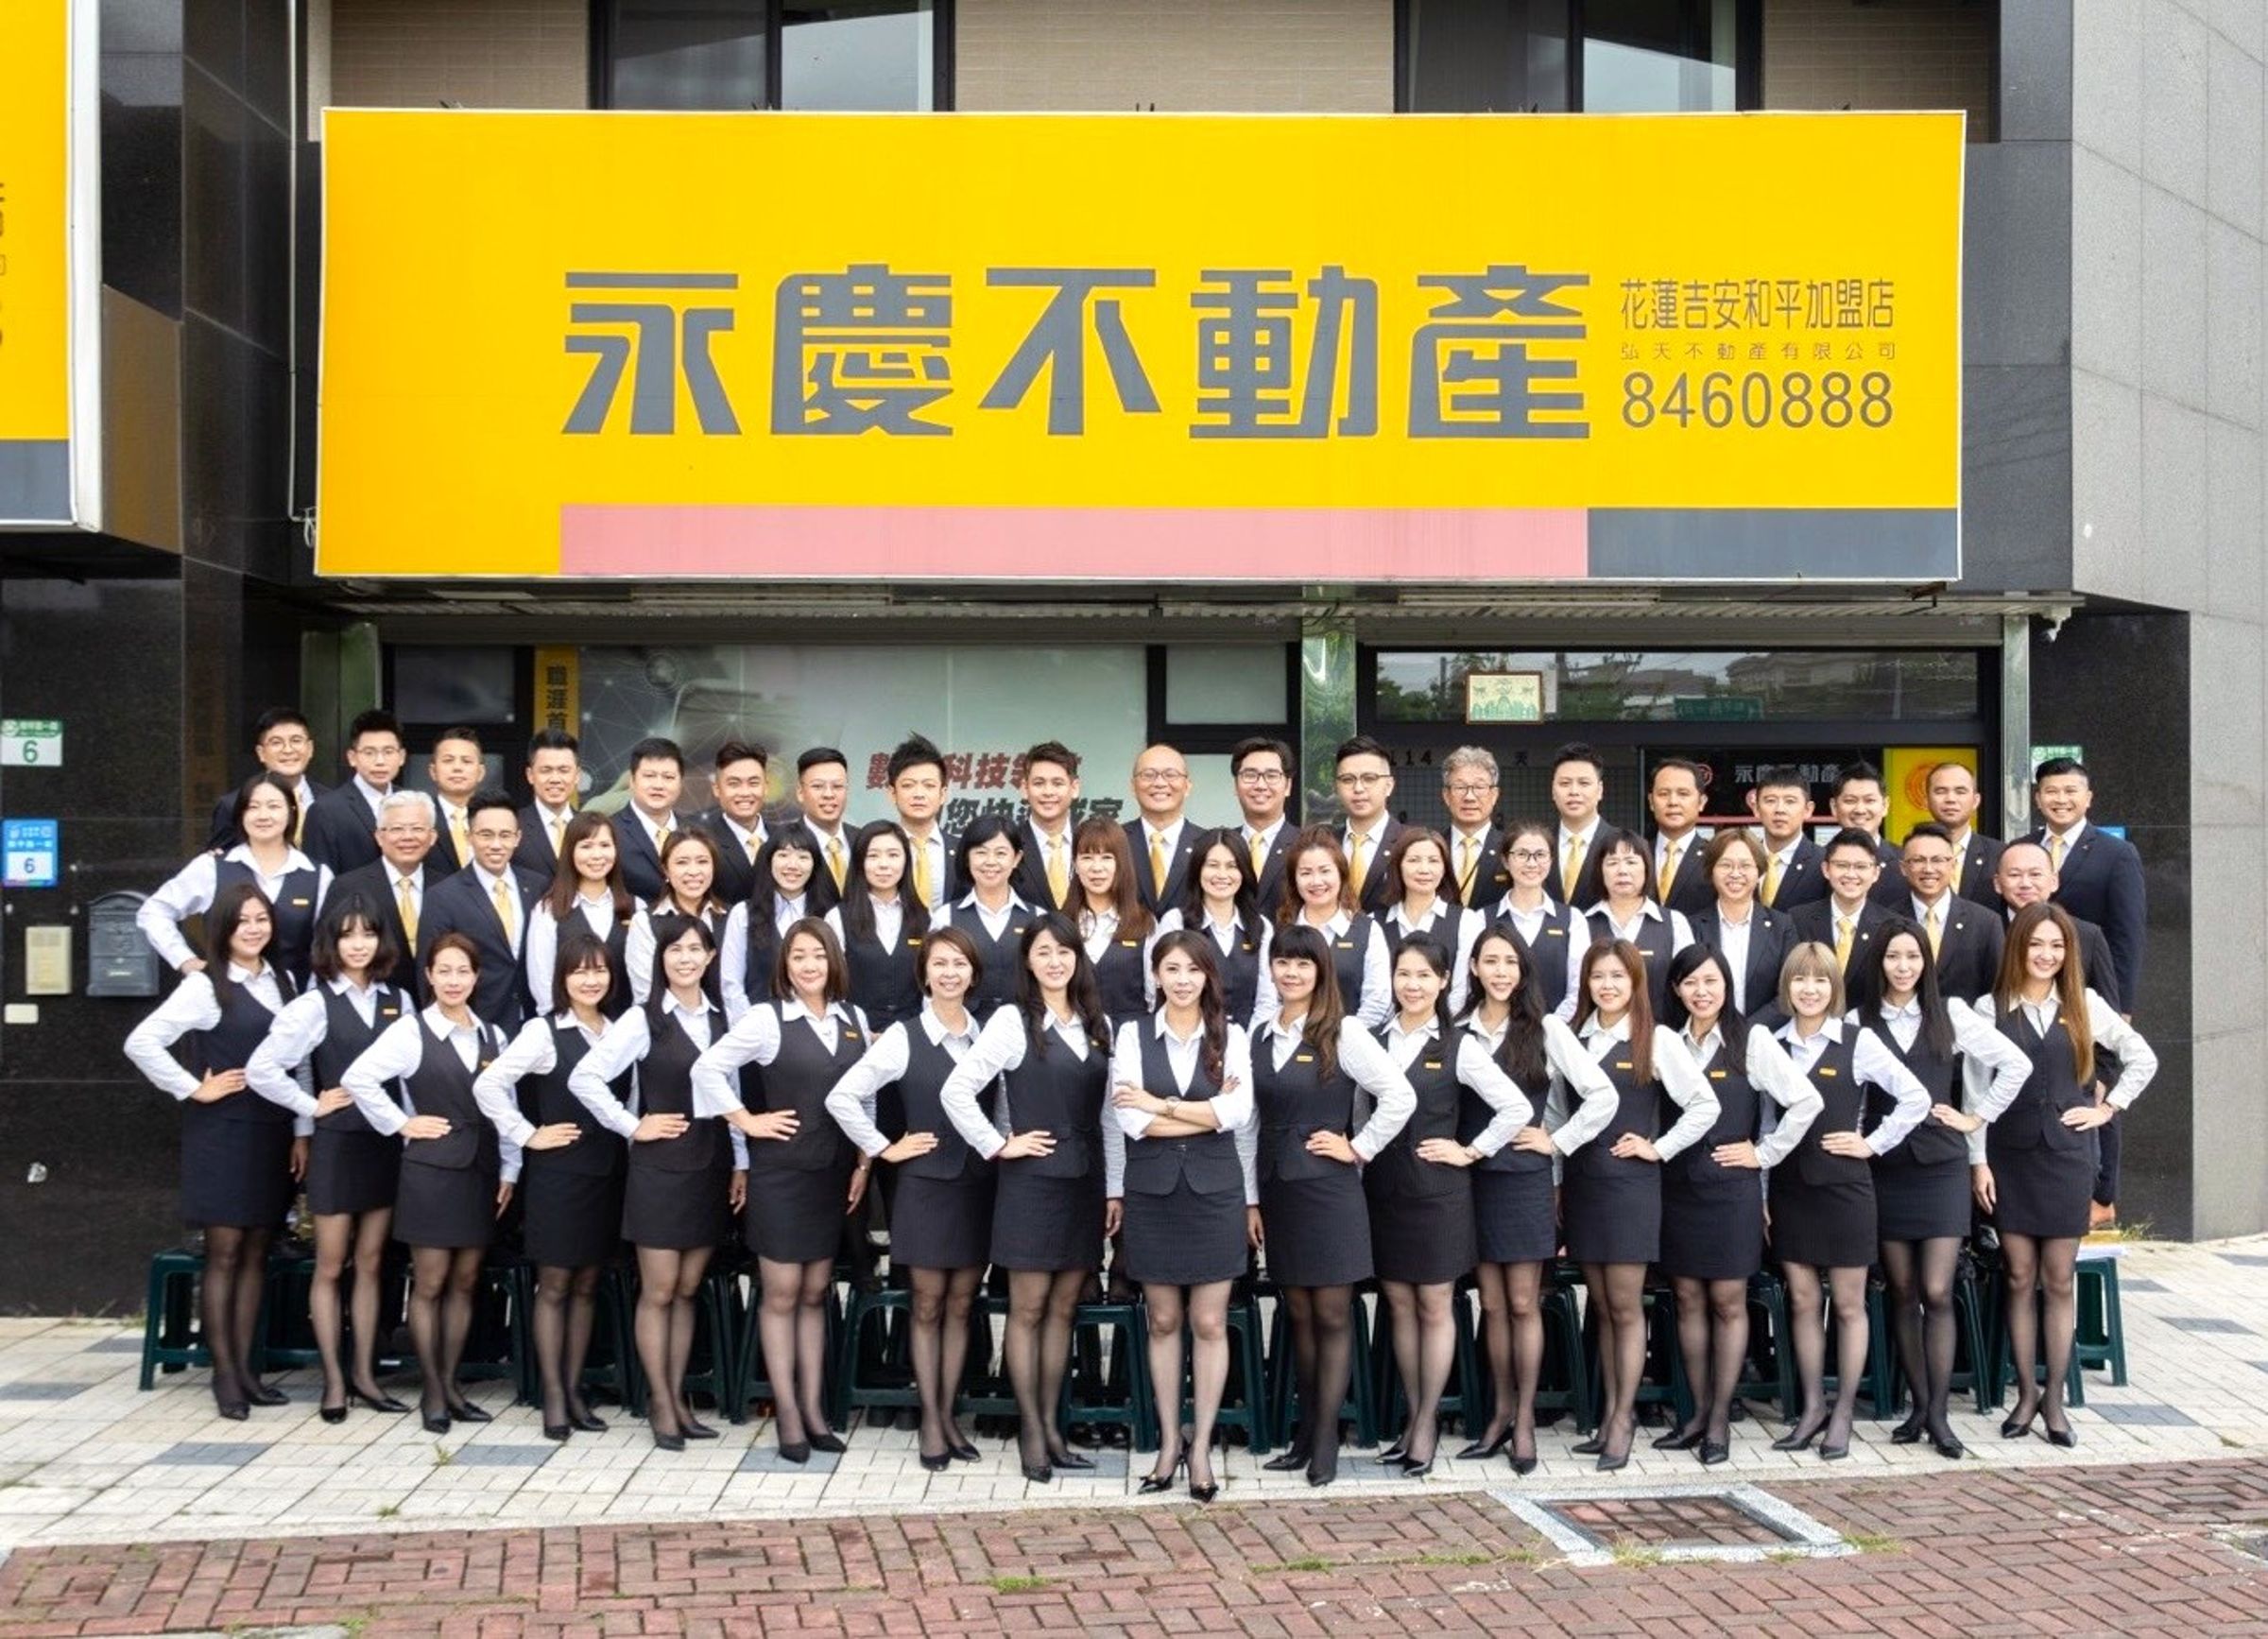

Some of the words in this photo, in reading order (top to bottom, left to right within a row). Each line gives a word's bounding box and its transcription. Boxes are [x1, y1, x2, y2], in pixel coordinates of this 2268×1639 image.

[1620, 278, 1895, 330] 花蓮吉安和平加盟店
[560, 264, 1590, 439] 永慶不動產
[1620, 341, 1897, 361] 弘天不動產有限公司
[1622, 371, 1893, 429] 8460888
[23, 740, 39, 764] 6
[24, 857, 36, 874] 6
